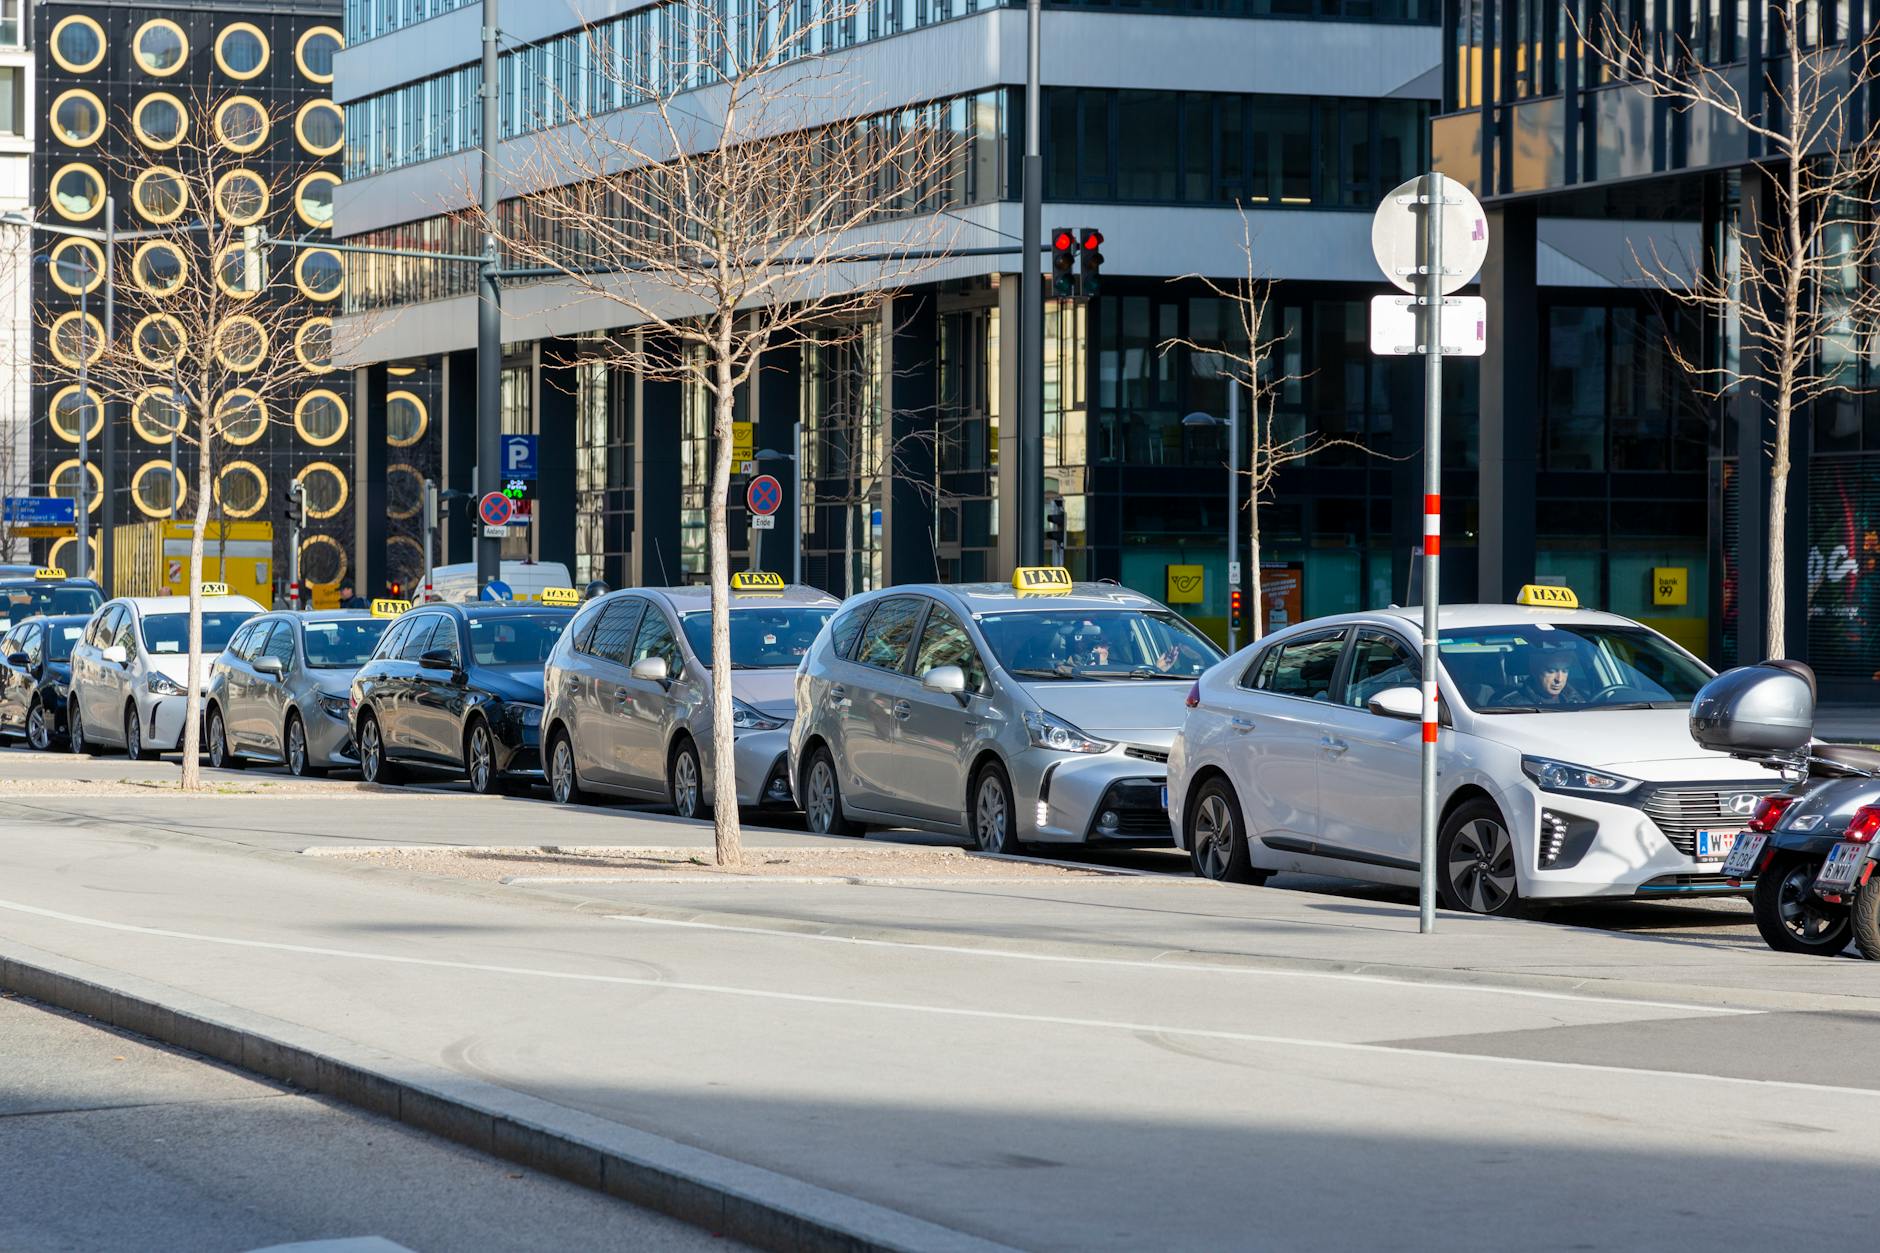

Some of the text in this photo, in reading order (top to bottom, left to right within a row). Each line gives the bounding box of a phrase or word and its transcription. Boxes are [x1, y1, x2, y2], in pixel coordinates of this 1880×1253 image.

[508, 445, 529, 470] P
[740, 574, 778, 584] TAXI
[1025, 570, 1068, 584] TAXI
[1659, 576, 1677, 585] bank
[1534, 588, 1571, 602] TAXI
[1659, 586, 1672, 597] 99
[1711, 834, 1722, 851] W
